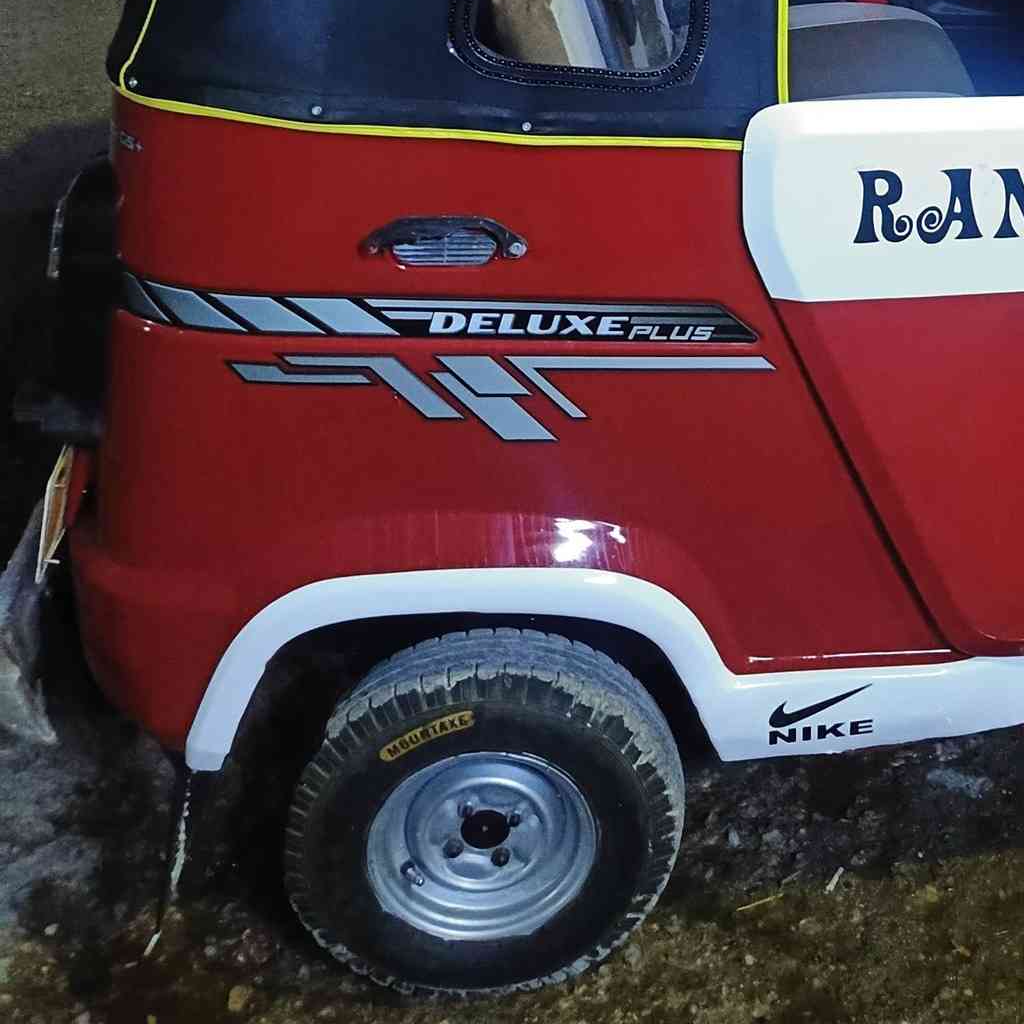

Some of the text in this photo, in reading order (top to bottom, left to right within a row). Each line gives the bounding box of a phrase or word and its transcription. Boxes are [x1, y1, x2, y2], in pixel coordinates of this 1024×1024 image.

[429, 311, 714, 340] DELUXE PLUS
[769, 719, 873, 745] NIKE
